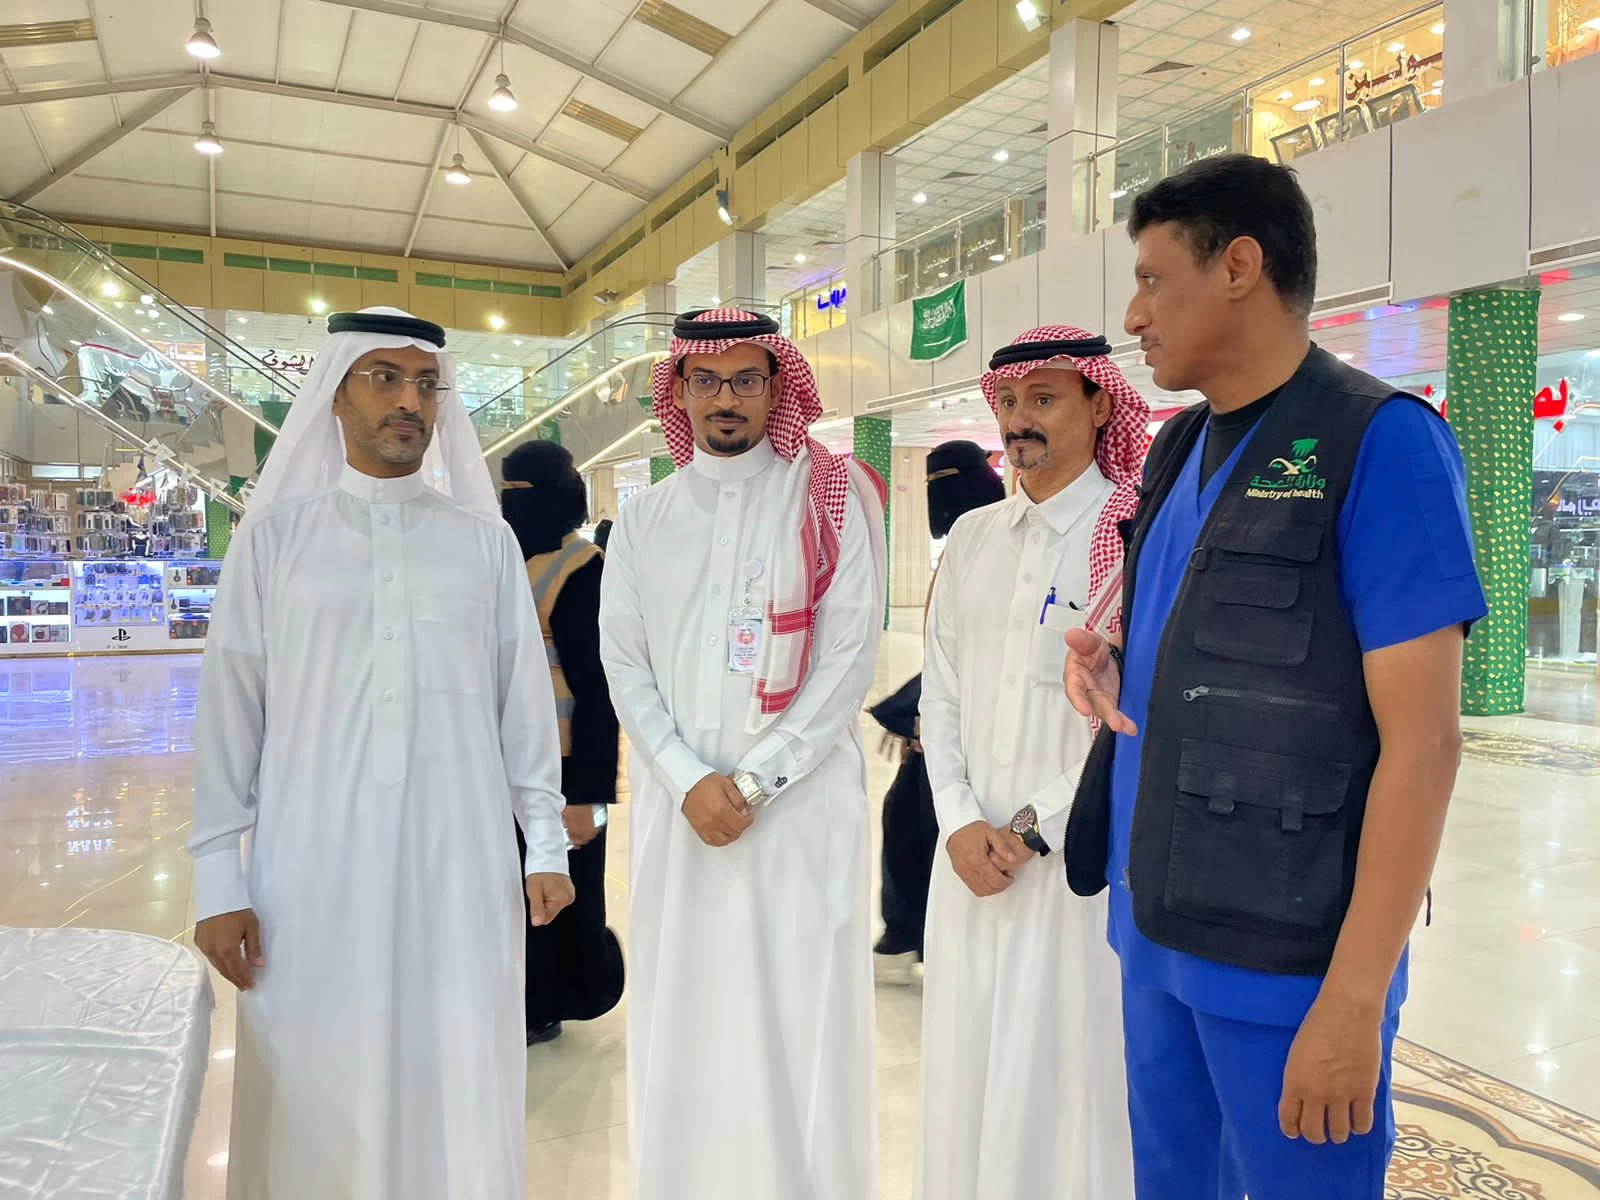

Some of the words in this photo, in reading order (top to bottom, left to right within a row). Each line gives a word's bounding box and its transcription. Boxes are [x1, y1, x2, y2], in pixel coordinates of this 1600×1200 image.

[1250, 475, 1295, 488] الصحة
[1295, 474, 1327, 489] وزارة
[1245, 488, 1283, 500] Ministry
[1283, 489, 1292, 498] of
[1292, 488, 1324, 500] health
